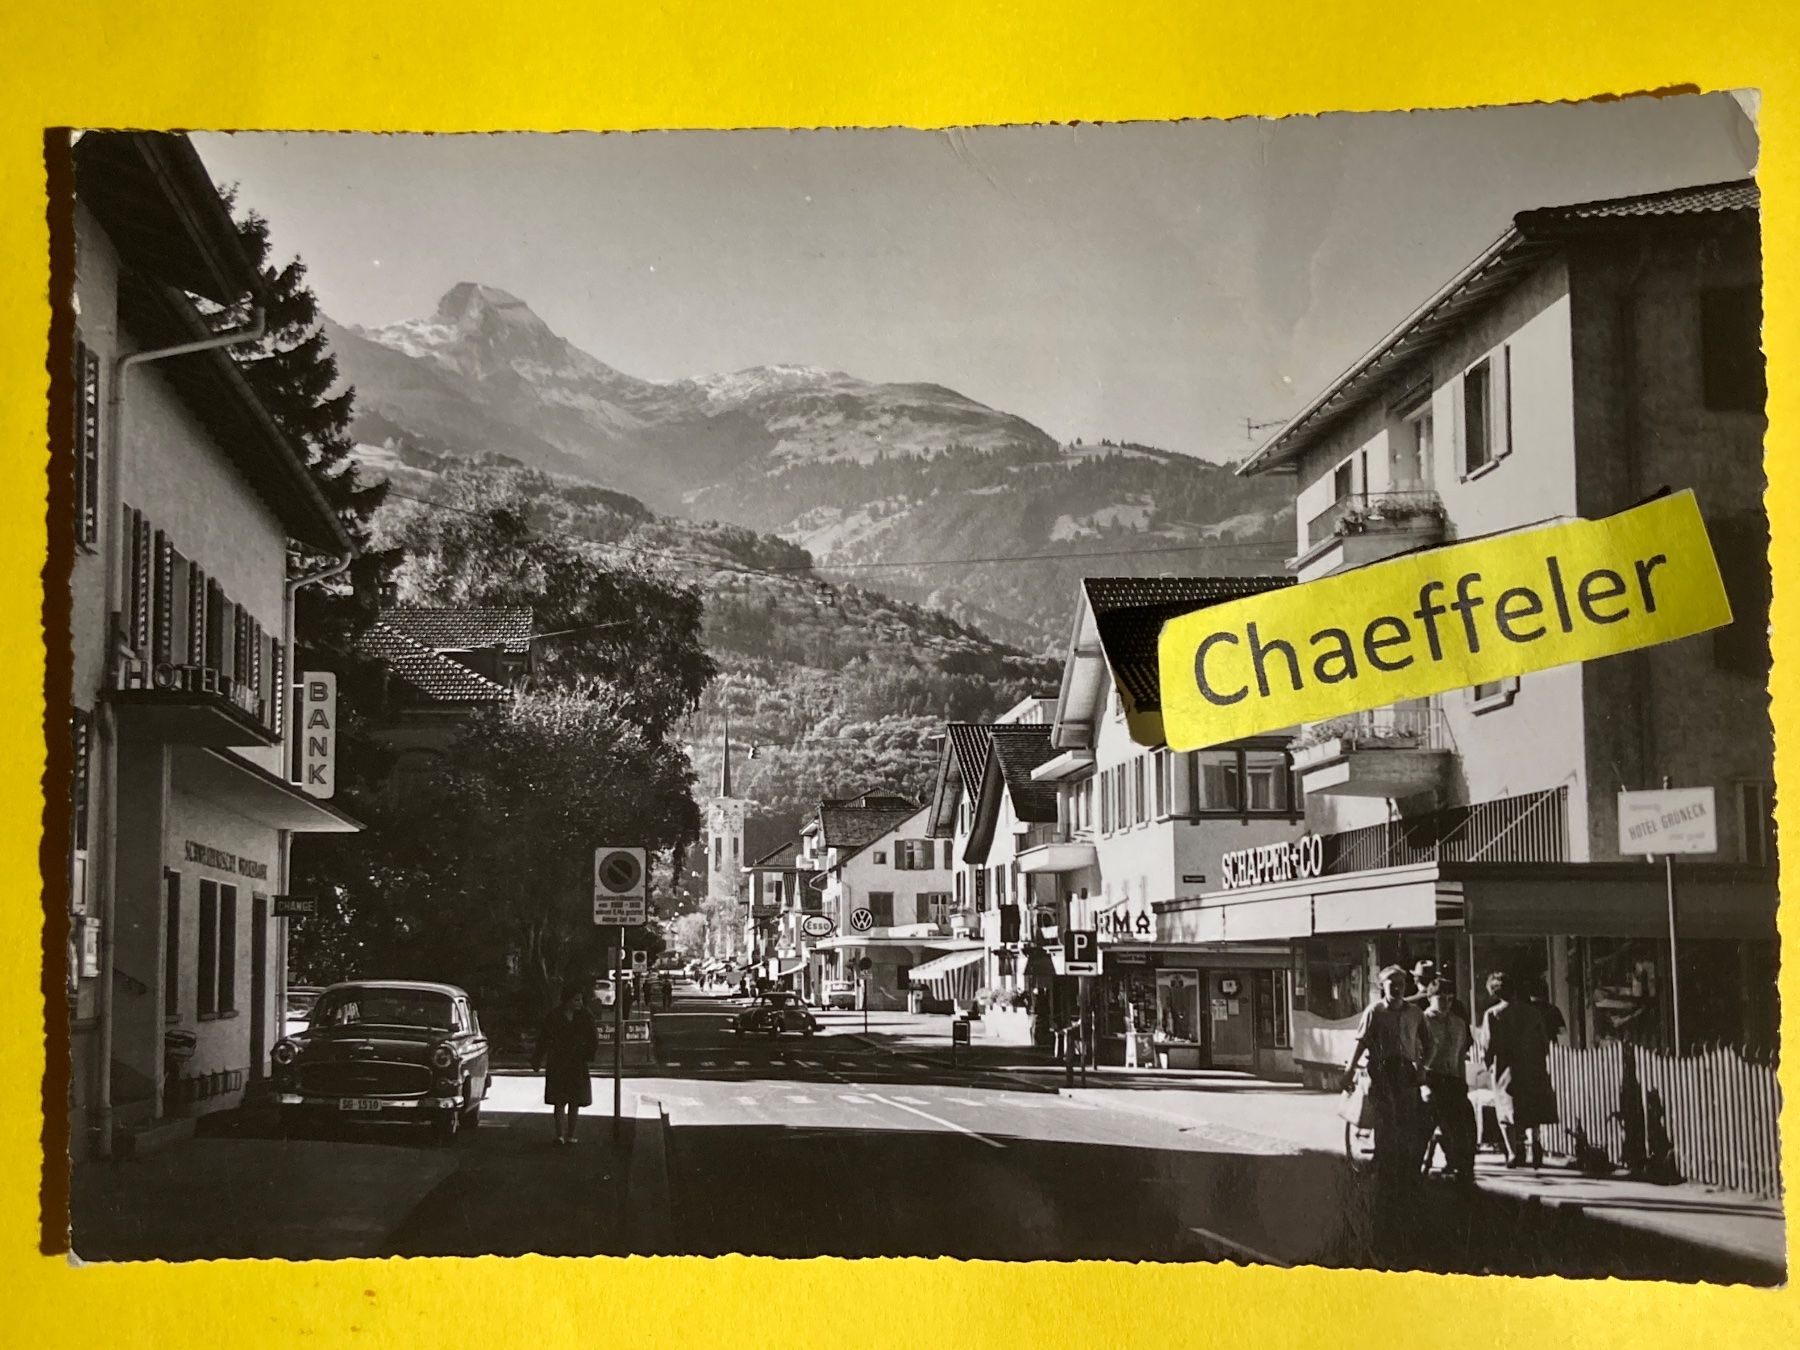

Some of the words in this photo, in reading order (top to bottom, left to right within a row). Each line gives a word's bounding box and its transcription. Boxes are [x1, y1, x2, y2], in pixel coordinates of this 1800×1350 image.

[1194, 554, 1667, 706] Chaeffeler
[124, 660, 224, 696] HOTEL
[307, 681, 330, 784] BANK
[1628, 819, 1658, 840] HOTEL
[279, 900, 314, 912] CHANGE
[1074, 934, 1088, 960] P
